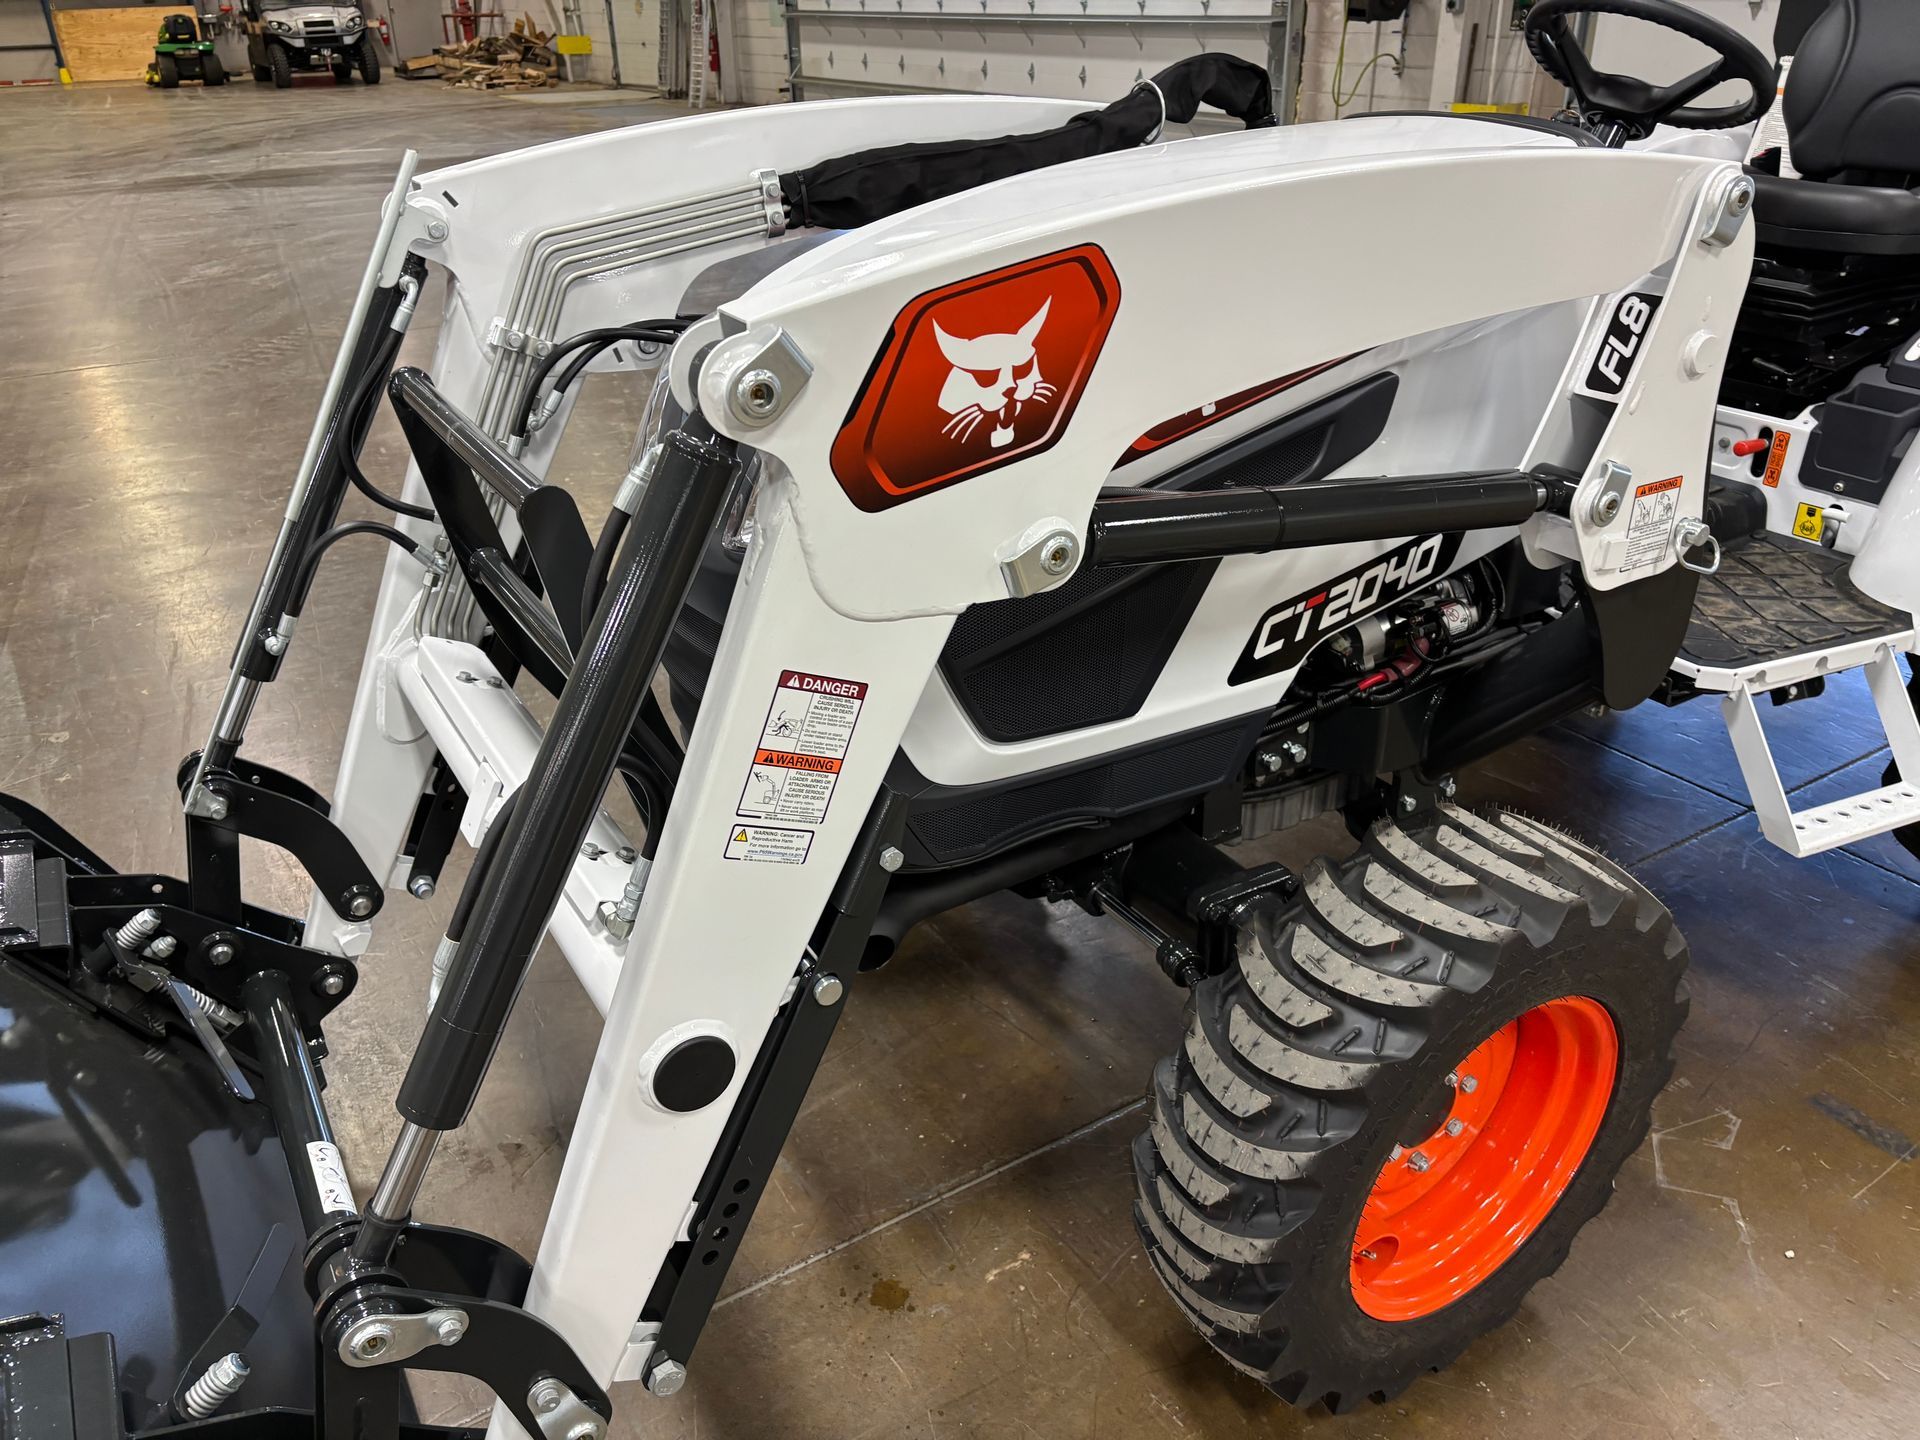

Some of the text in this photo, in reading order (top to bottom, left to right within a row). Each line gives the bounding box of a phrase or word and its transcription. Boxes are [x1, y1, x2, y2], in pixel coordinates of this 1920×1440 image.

[1598, 296, 1650, 386] FL8
[1648, 479, 1678, 492] WARNING
[1253, 533, 1443, 660] CT2040
[802, 677, 859, 697] DANGER
[776, 754, 834, 771] WARNING
[788, 781, 819, 789] ATTACHMENT
